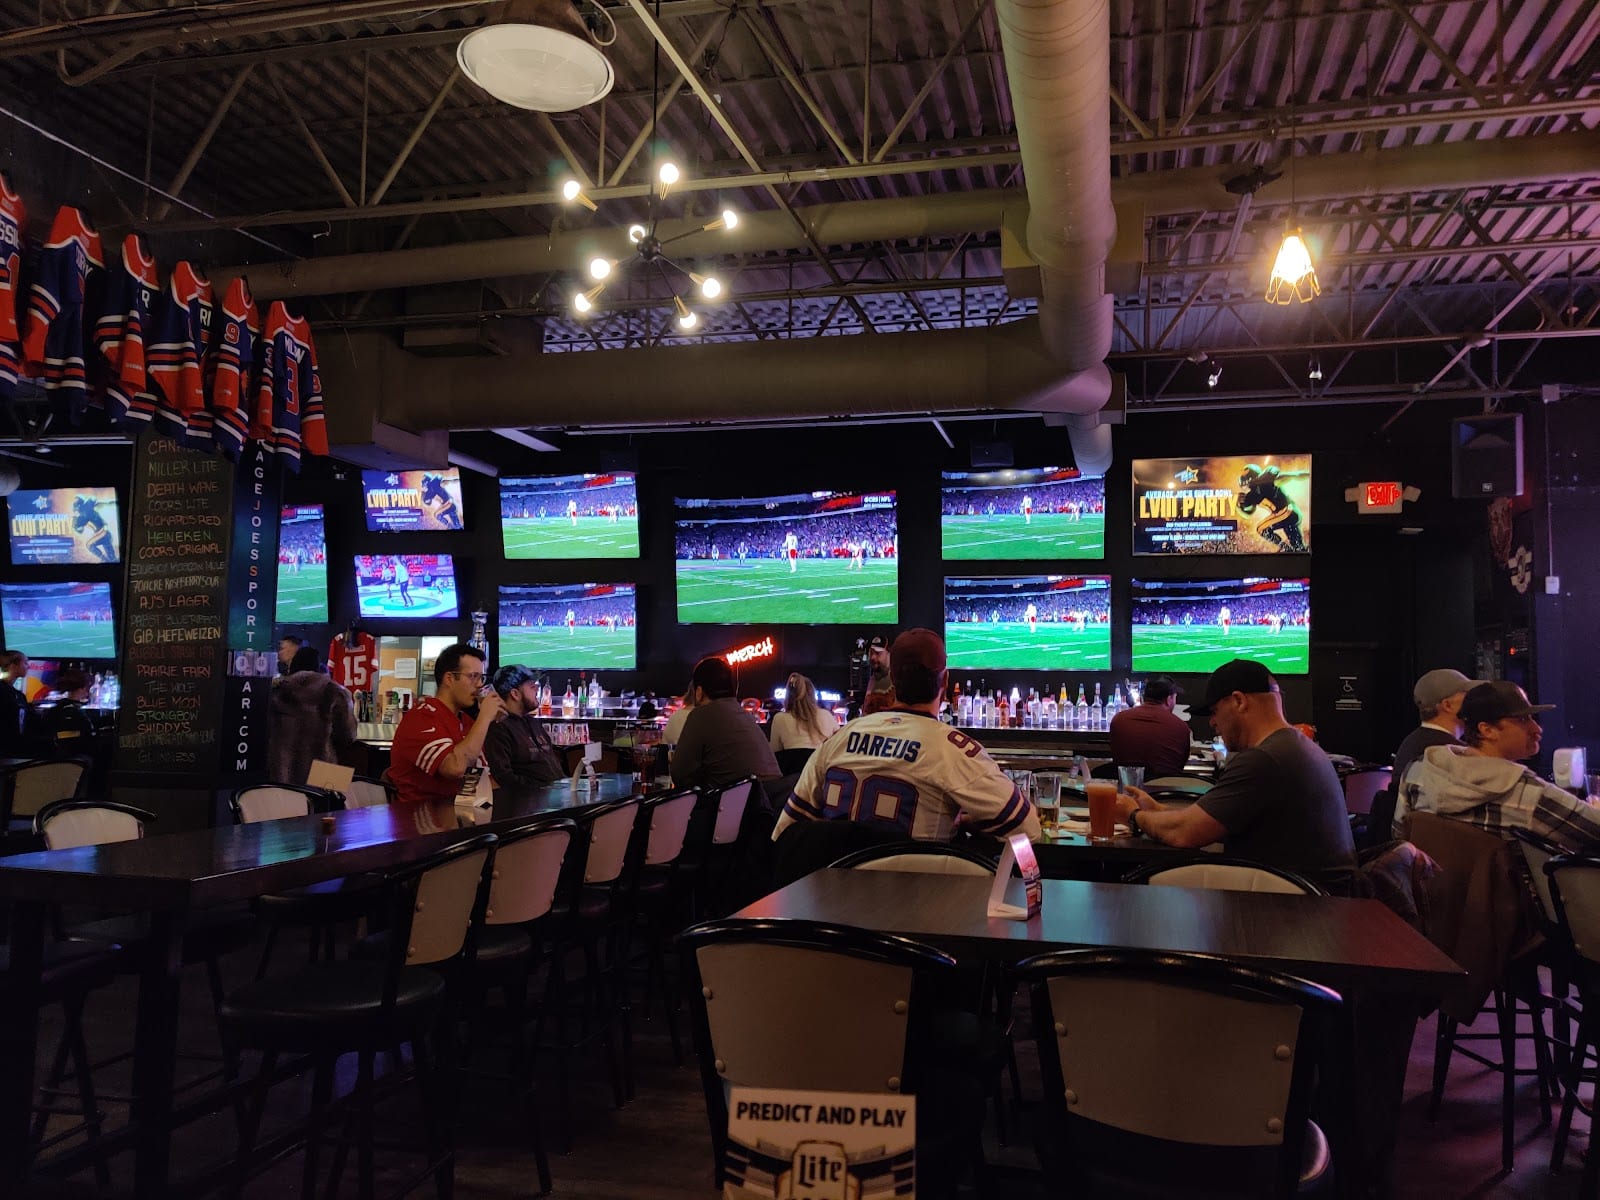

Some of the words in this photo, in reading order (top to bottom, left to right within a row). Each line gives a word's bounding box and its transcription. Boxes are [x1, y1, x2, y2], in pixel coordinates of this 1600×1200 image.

[147, 481, 185, 498] DEATH
[1140, 496, 1177, 519] LVIII
[1182, 495, 1239, 518] PARTY
[198, 514, 222, 527] RED
[139, 546, 176, 561] COORS
[177, 543, 224, 557] ORIGINAL
[202, 575, 220, 588] SOUR
[139, 595, 165, 610] AJ'S
[168, 594, 210, 609] LAGER
[133, 629, 154, 645] GIB
[156, 626, 221, 644] HEFEWEIZEN
[726, 636, 774, 666] MERCH
[343, 654, 368, 687] 15
[144, 680, 168, 694] THE
[136, 694, 168, 709] BLUE
[135, 710, 200, 723] STRONGBOW
[846, 732, 922, 763] DAREUS
[736, 1102, 813, 1122] PREDICT
[816, 1105, 856, 1125] AND
[860, 1107, 907, 1128] PLAY
[798, 1154, 842, 1188] Lite
